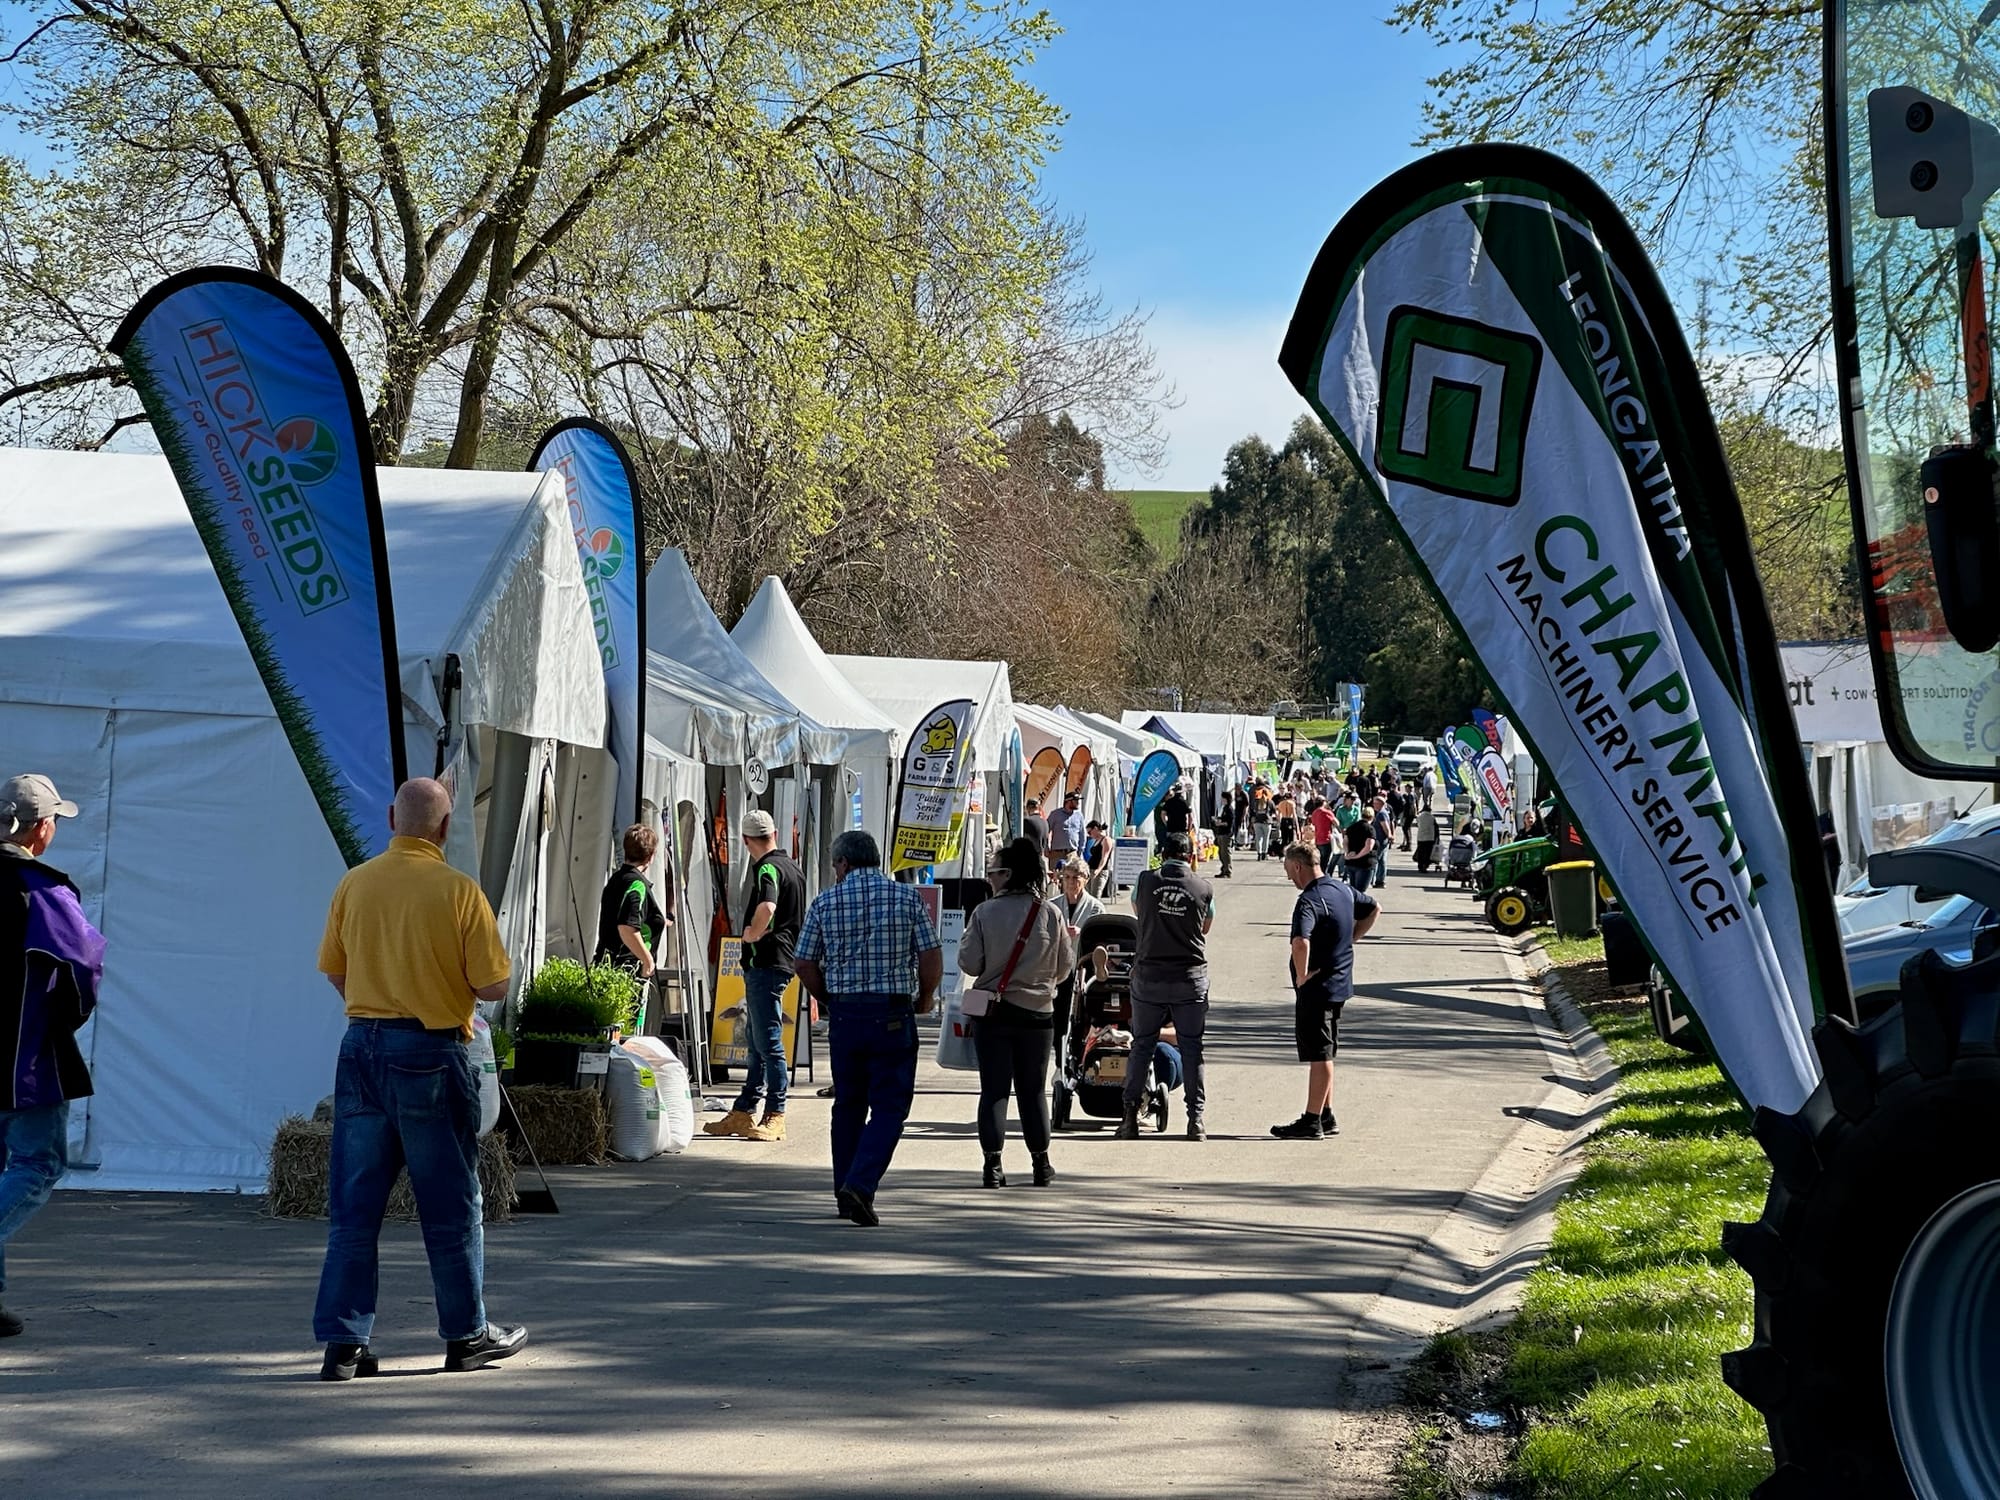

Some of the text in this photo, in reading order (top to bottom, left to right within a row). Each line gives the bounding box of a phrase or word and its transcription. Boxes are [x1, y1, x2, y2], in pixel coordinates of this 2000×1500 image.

[1558, 271, 1692, 562] LEONGATHA
[186, 399, 270, 560] For Quality Feed
[1844, 688, 1868, 700] COW
[749, 764, 764, 784] 32
[914, 757, 954, 775] G & S
[1497, 554, 1741, 933] MACHINERY SERVICE
